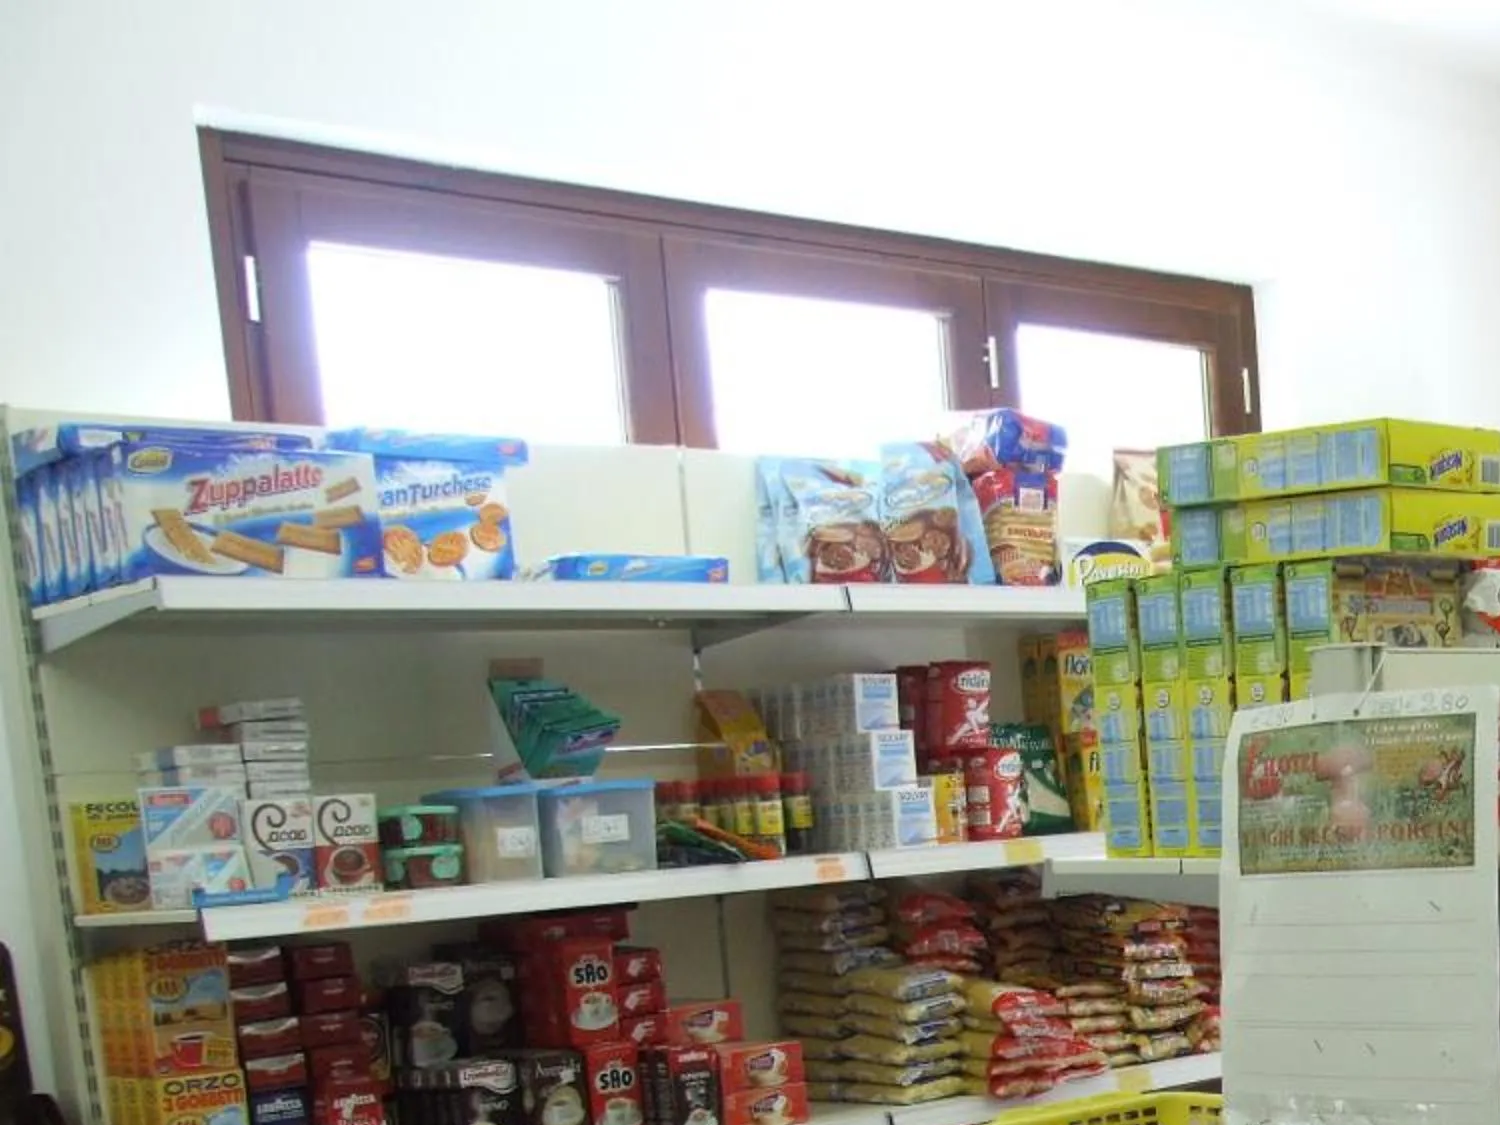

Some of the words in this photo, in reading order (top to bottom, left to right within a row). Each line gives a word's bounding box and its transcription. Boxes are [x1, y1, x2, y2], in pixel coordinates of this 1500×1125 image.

[184, 463, 323, 516] Zuppalatte
[379, 473, 492, 507] anTurchese
[162, 1073, 240, 1096] ORZO
